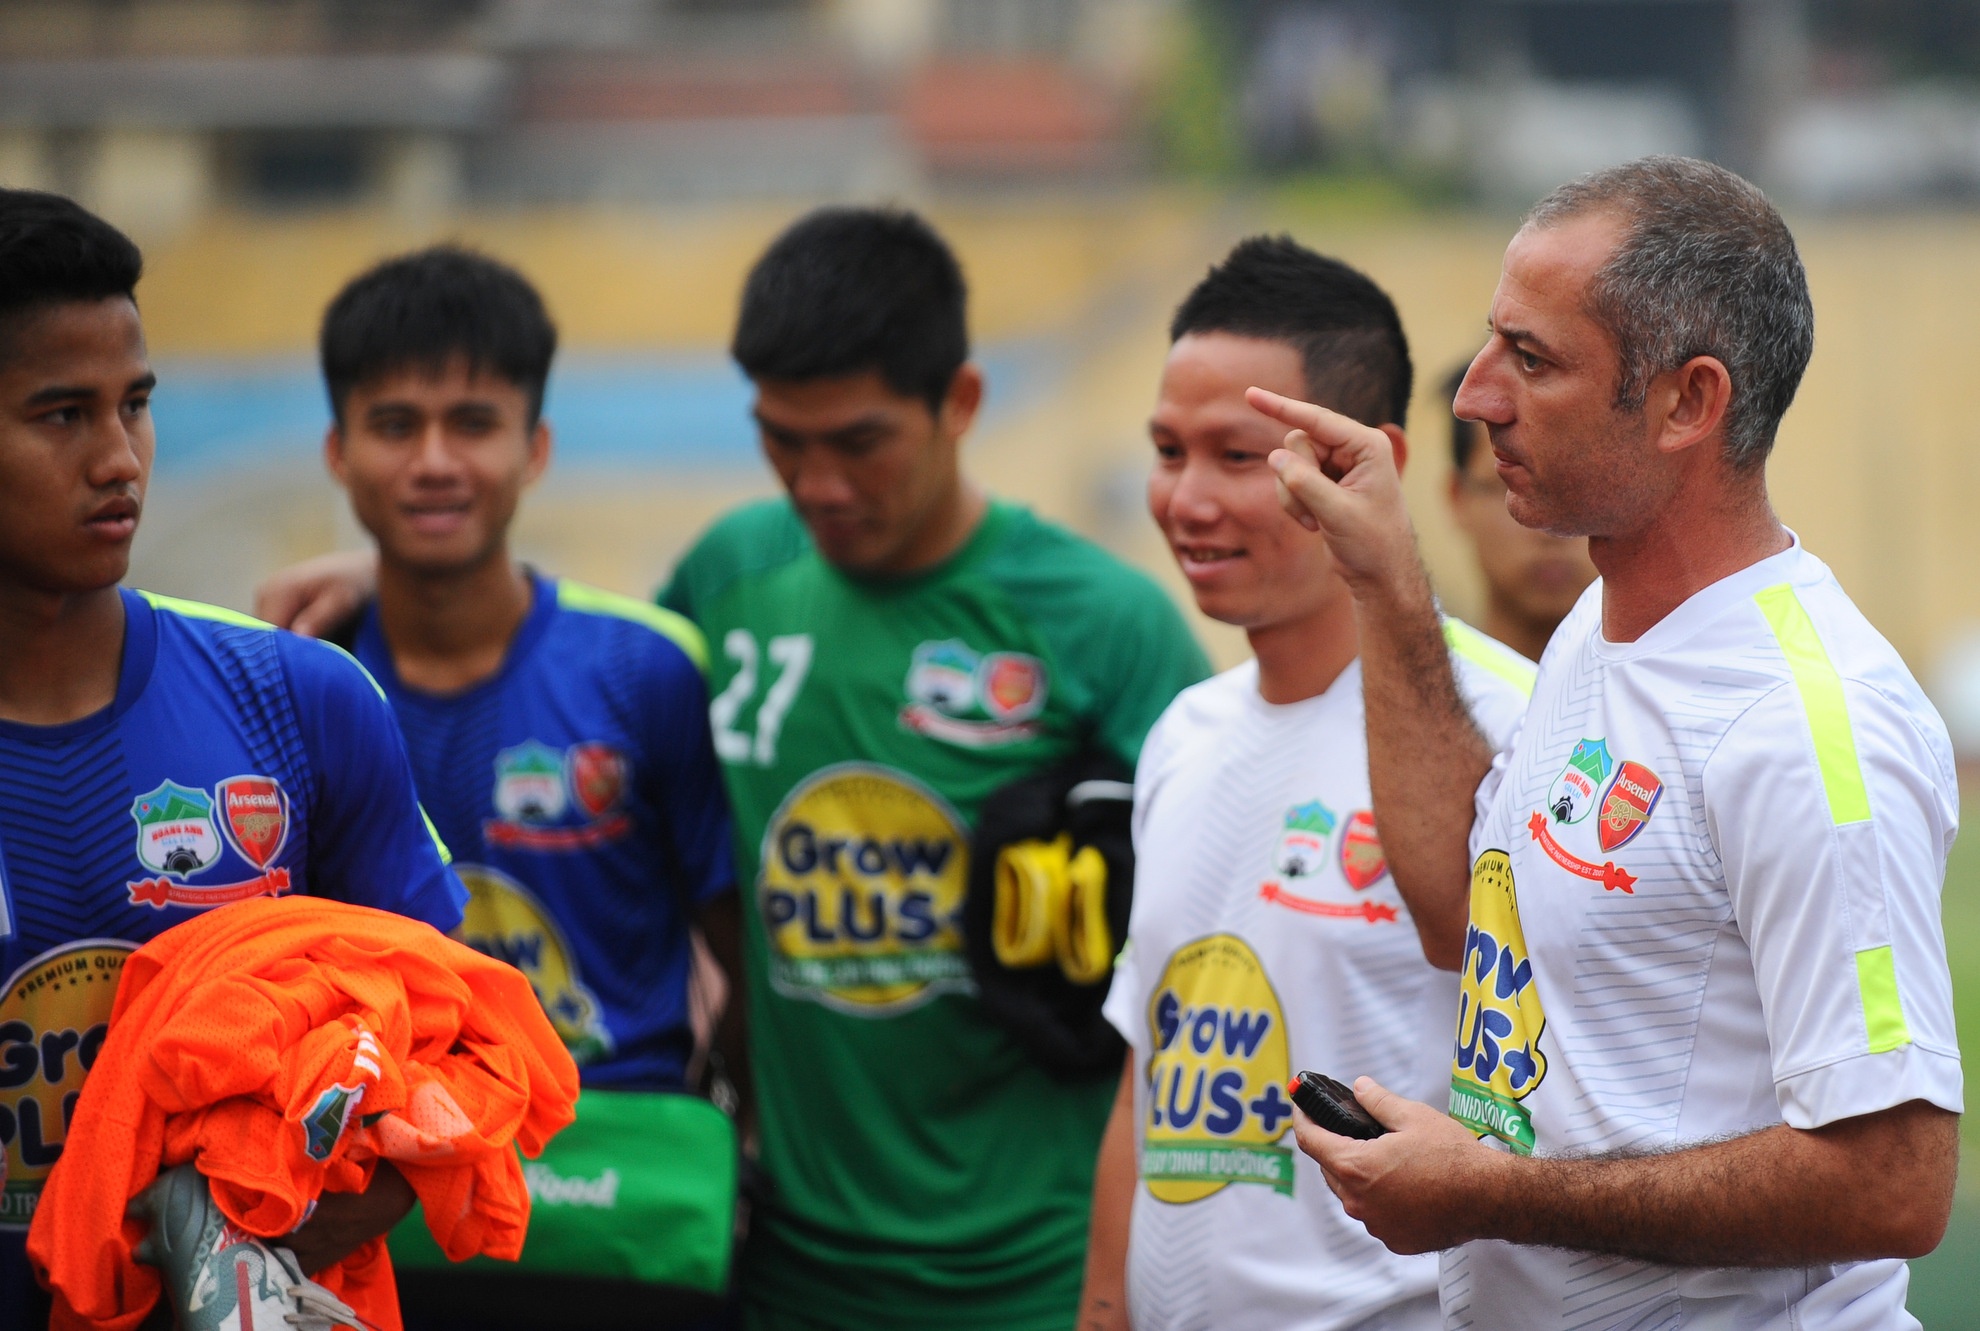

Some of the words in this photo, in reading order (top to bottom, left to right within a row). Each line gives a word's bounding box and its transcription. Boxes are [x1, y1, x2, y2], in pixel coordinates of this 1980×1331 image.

[709, 628, 815, 766] 27
[228, 791, 277, 807] Arsenal
[1579, 780, 1592, 799] ANH
[1617, 772, 1654, 803] Arsenal
[779, 822, 952, 876] Grow
[18, 958, 88, 999] PREMIUM
[1157, 991, 1269, 1057] Gow
